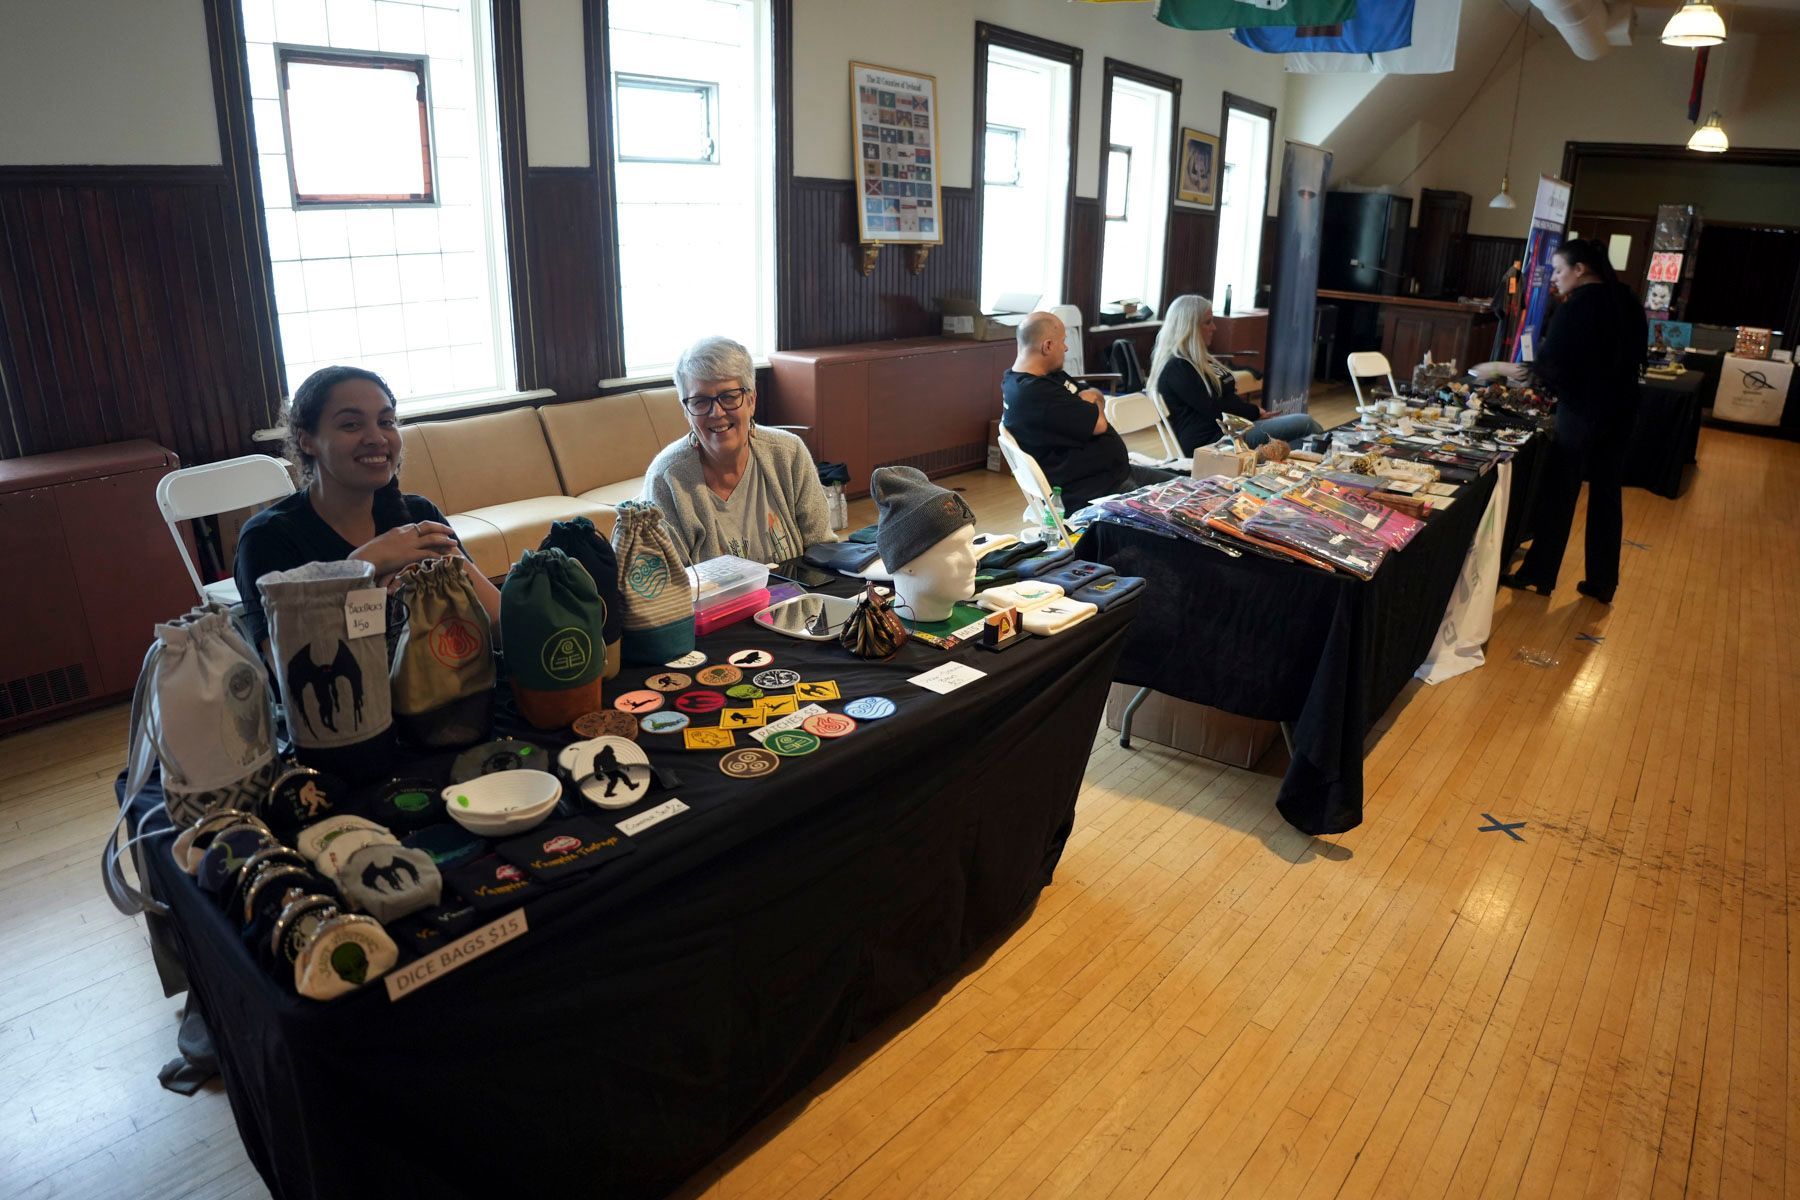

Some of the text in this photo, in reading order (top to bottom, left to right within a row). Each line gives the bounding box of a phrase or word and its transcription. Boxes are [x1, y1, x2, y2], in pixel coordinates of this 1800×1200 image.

[866, 73, 876, 84] The
[758, 714, 804, 737] PATCHES
[396, 918, 519, 991] DICE BAGS $15
